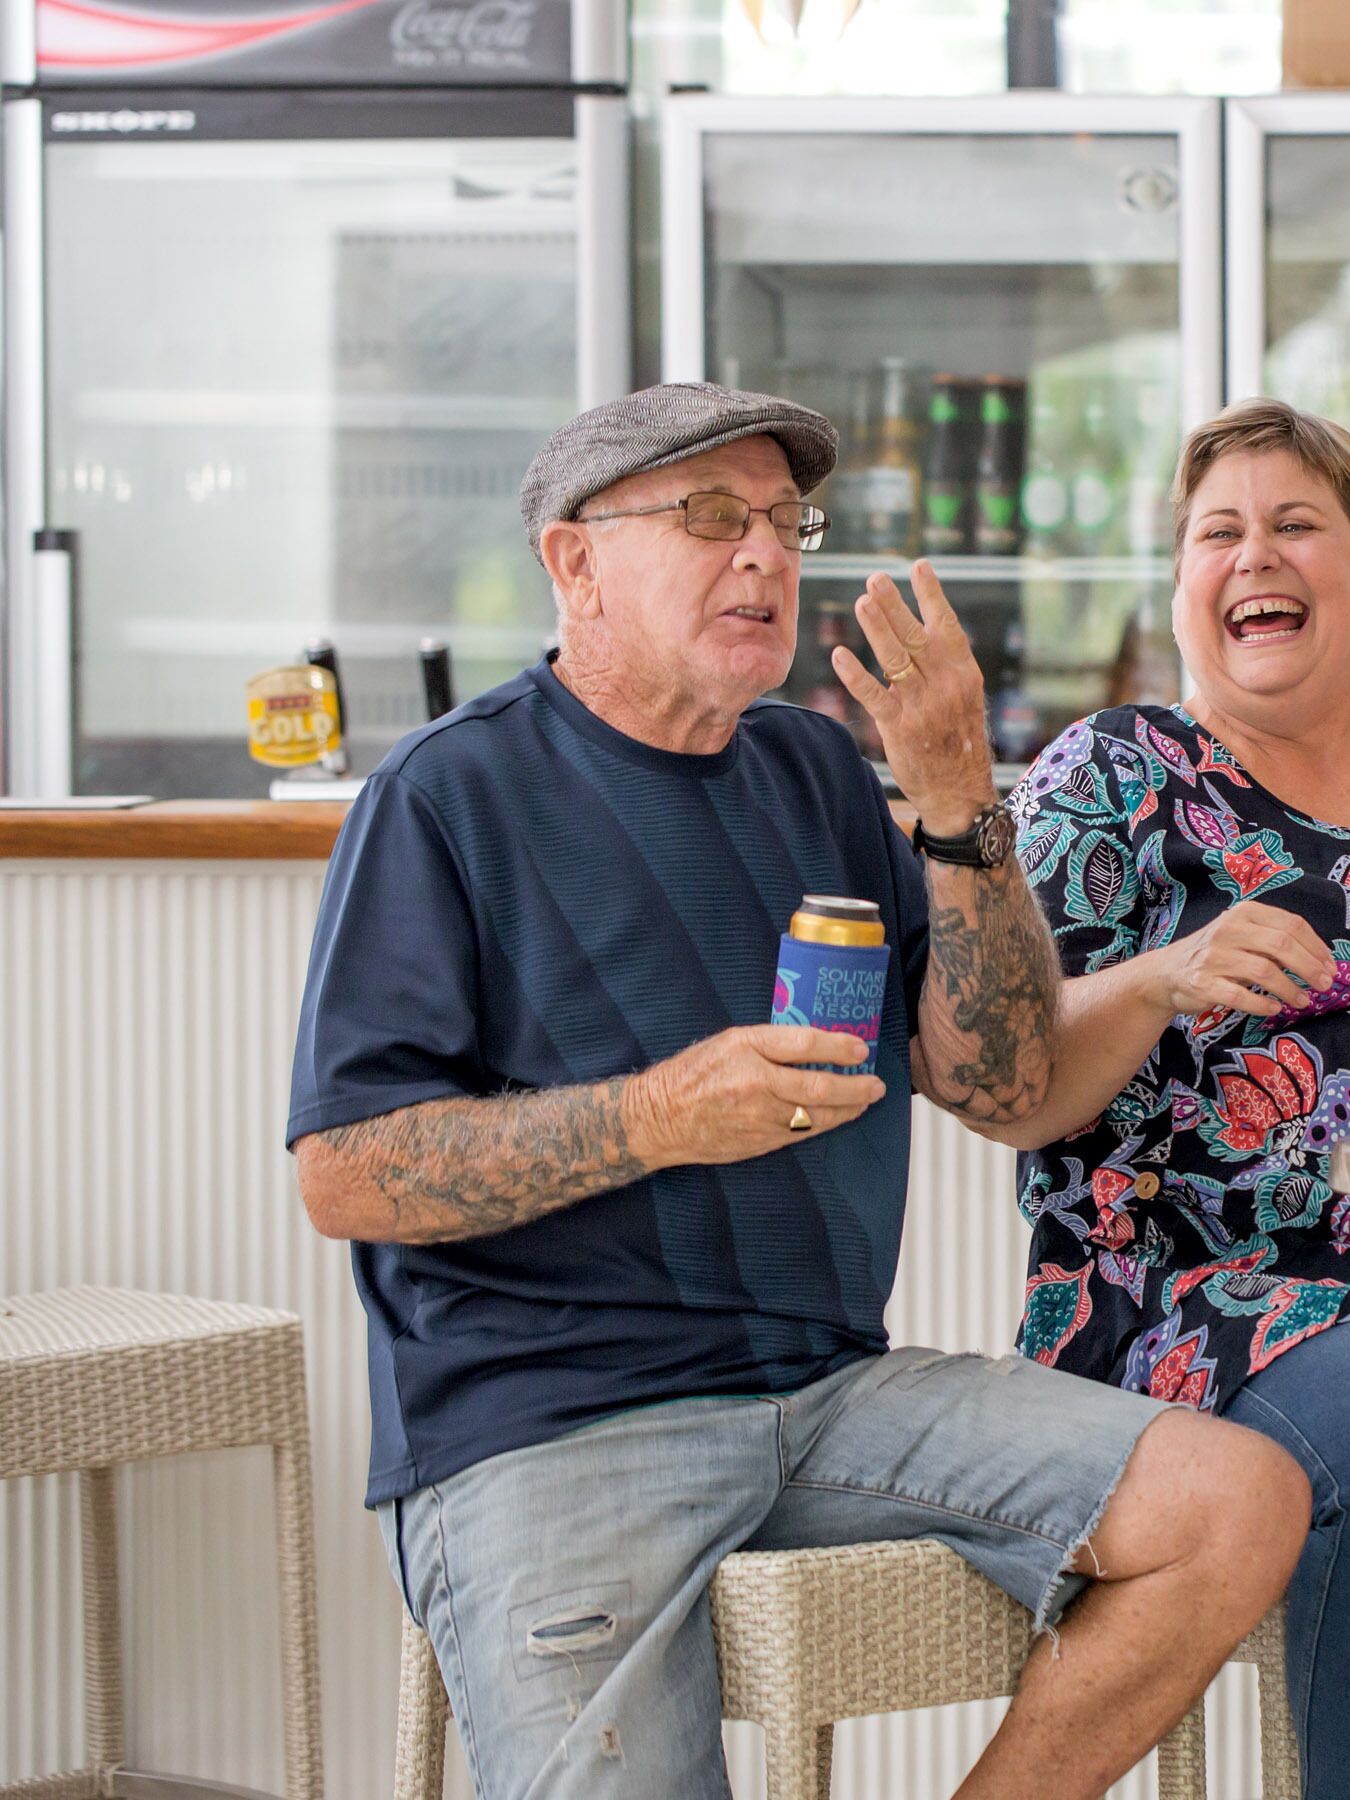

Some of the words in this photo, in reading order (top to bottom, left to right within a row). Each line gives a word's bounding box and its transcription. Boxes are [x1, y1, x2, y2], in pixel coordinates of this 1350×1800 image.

[250, 711, 335, 746] GOLD
[818, 966, 887, 985] SOLITARY
[816, 980, 885, 998] ISLANDS
[812, 1001, 882, 1020] RESORT
